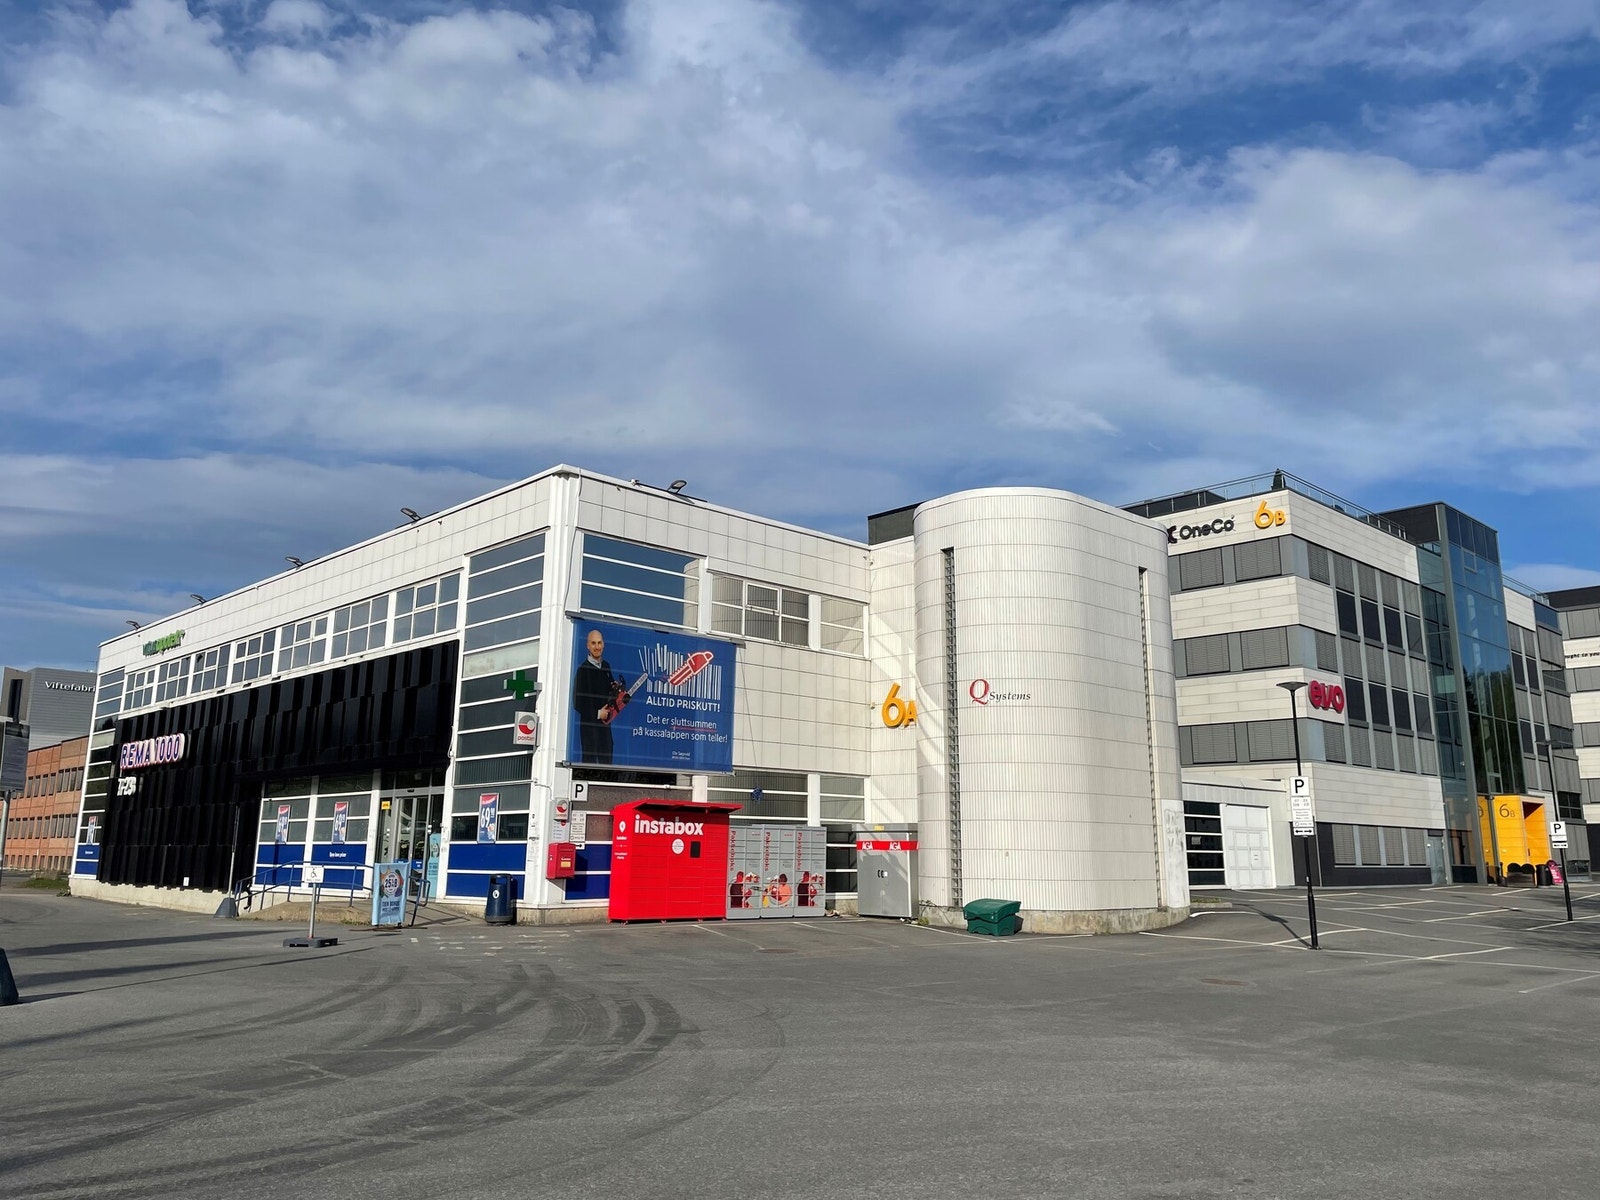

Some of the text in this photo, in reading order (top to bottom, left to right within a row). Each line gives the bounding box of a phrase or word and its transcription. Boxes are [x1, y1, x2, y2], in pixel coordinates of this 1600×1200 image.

[1254, 501, 1285, 529] 6B
[1180, 518, 1234, 540] OneCo
[646, 696, 720, 712] ALLTID PRISKUTT!
[989, 692, 1031, 703] Systems
[1308, 680, 1344, 714] evo
[882, 682, 917, 728] 6A
[647, 714, 660, 724] Det
[670, 717, 717, 729] sluttsummen
[632, 727, 643, 736] på
[644, 728, 690, 740] kassalappen
[120, 733, 185, 769] REMA 1000
[575, 784, 584, 798] P
[1294, 779, 1305, 794] P
[1499, 803, 1515, 818] 6B
[634, 814, 704, 836] instabox
[1553, 823, 1562, 834] P
